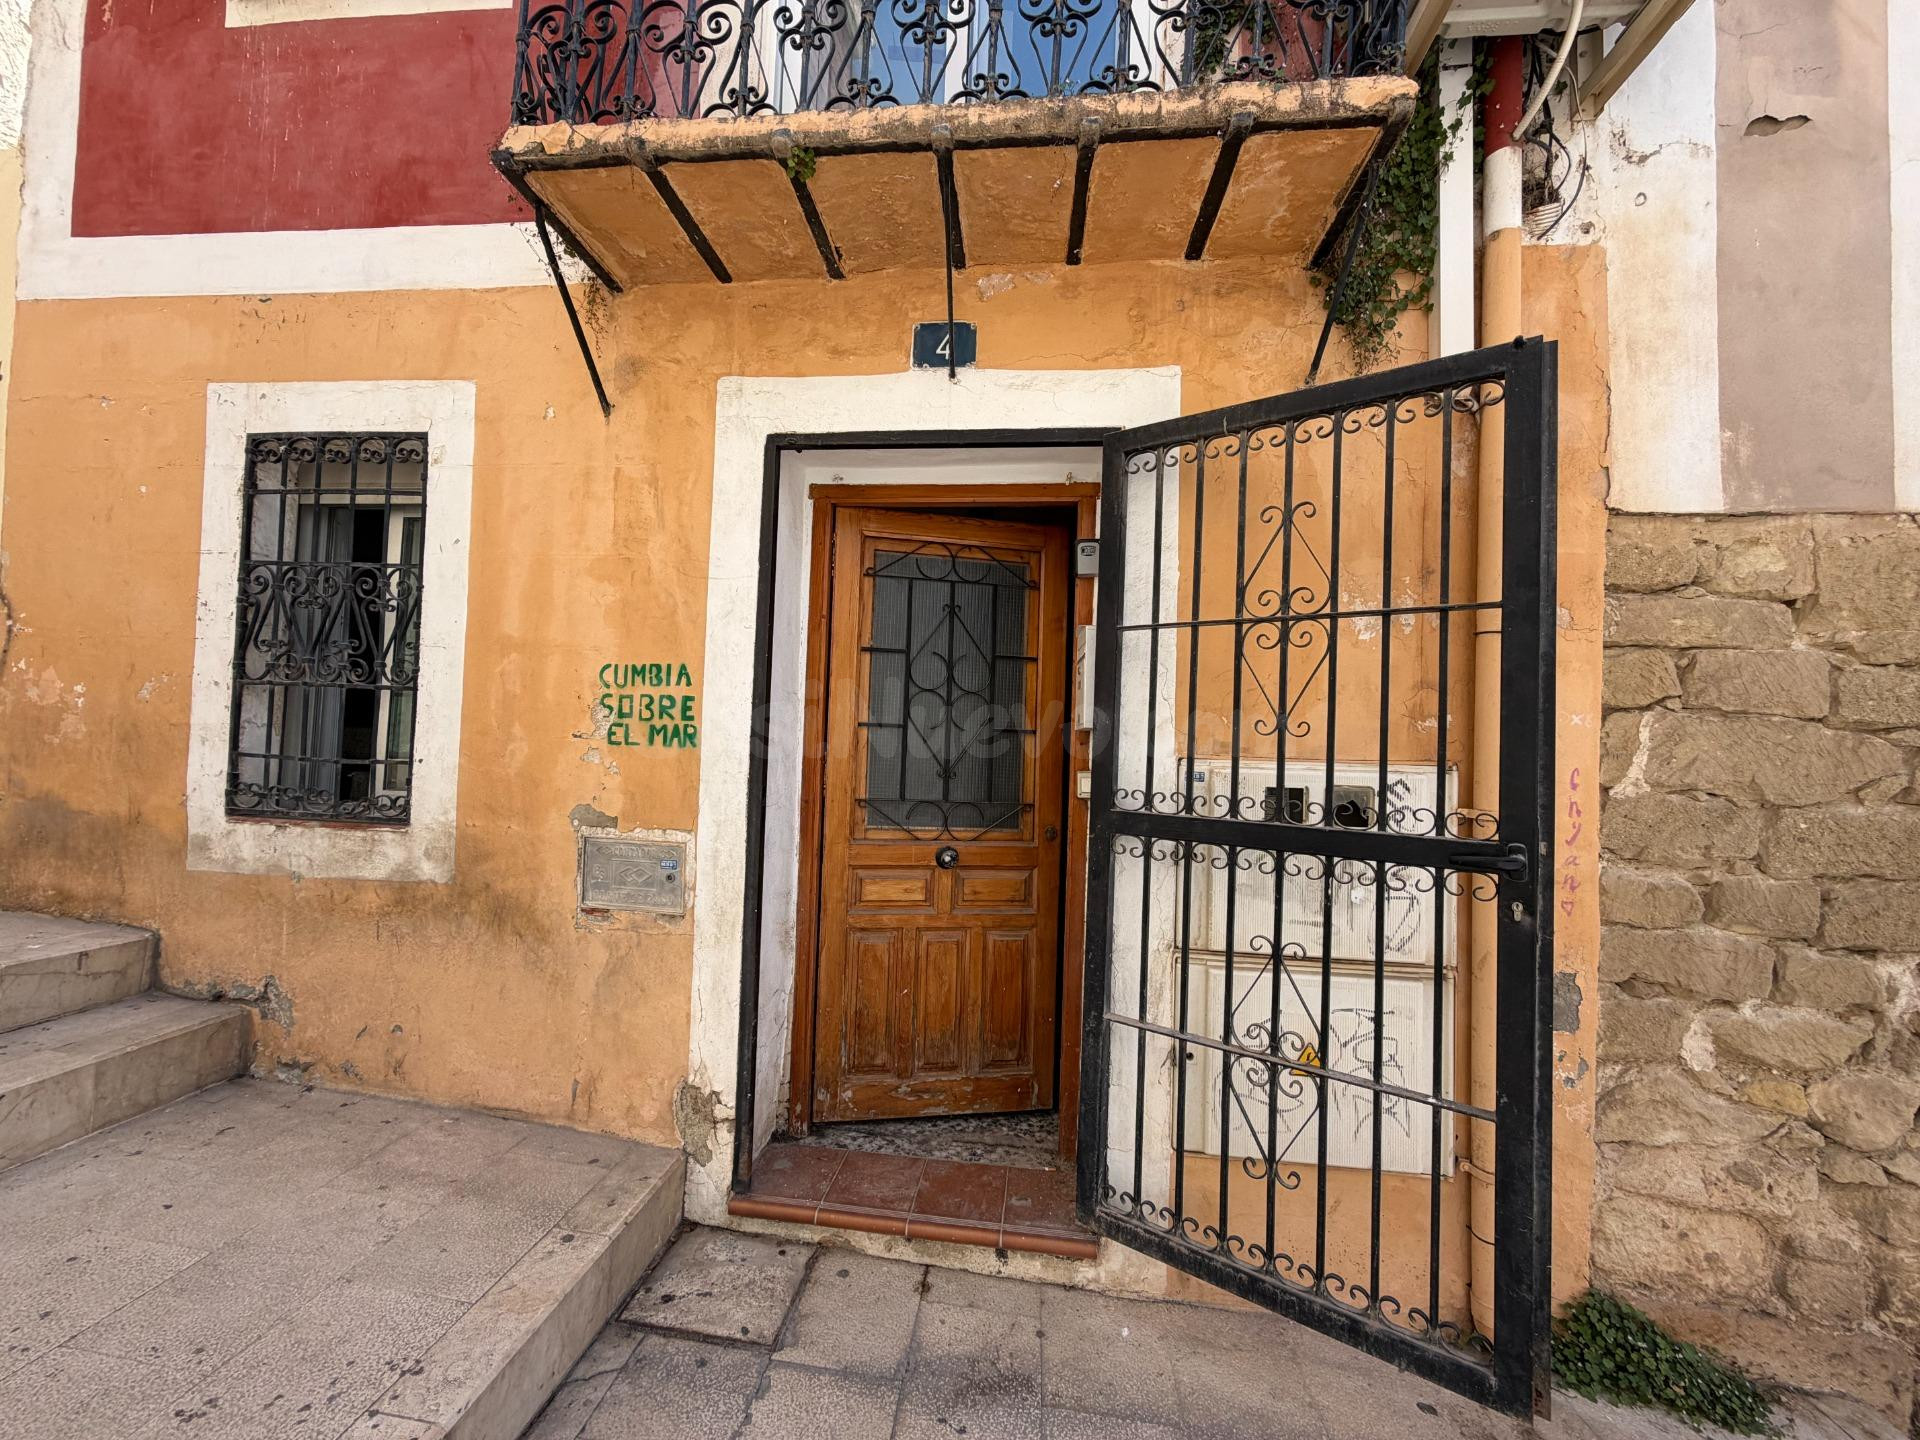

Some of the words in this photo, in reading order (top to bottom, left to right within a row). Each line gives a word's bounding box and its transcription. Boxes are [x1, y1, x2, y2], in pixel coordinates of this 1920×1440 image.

[936, 333, 951, 360] 4
[599, 663, 692, 689] CUMBIA
[600, 693, 695, 721] SOBRE
[608, 722, 640, 746] EL
[648, 723, 697, 748] MAR
